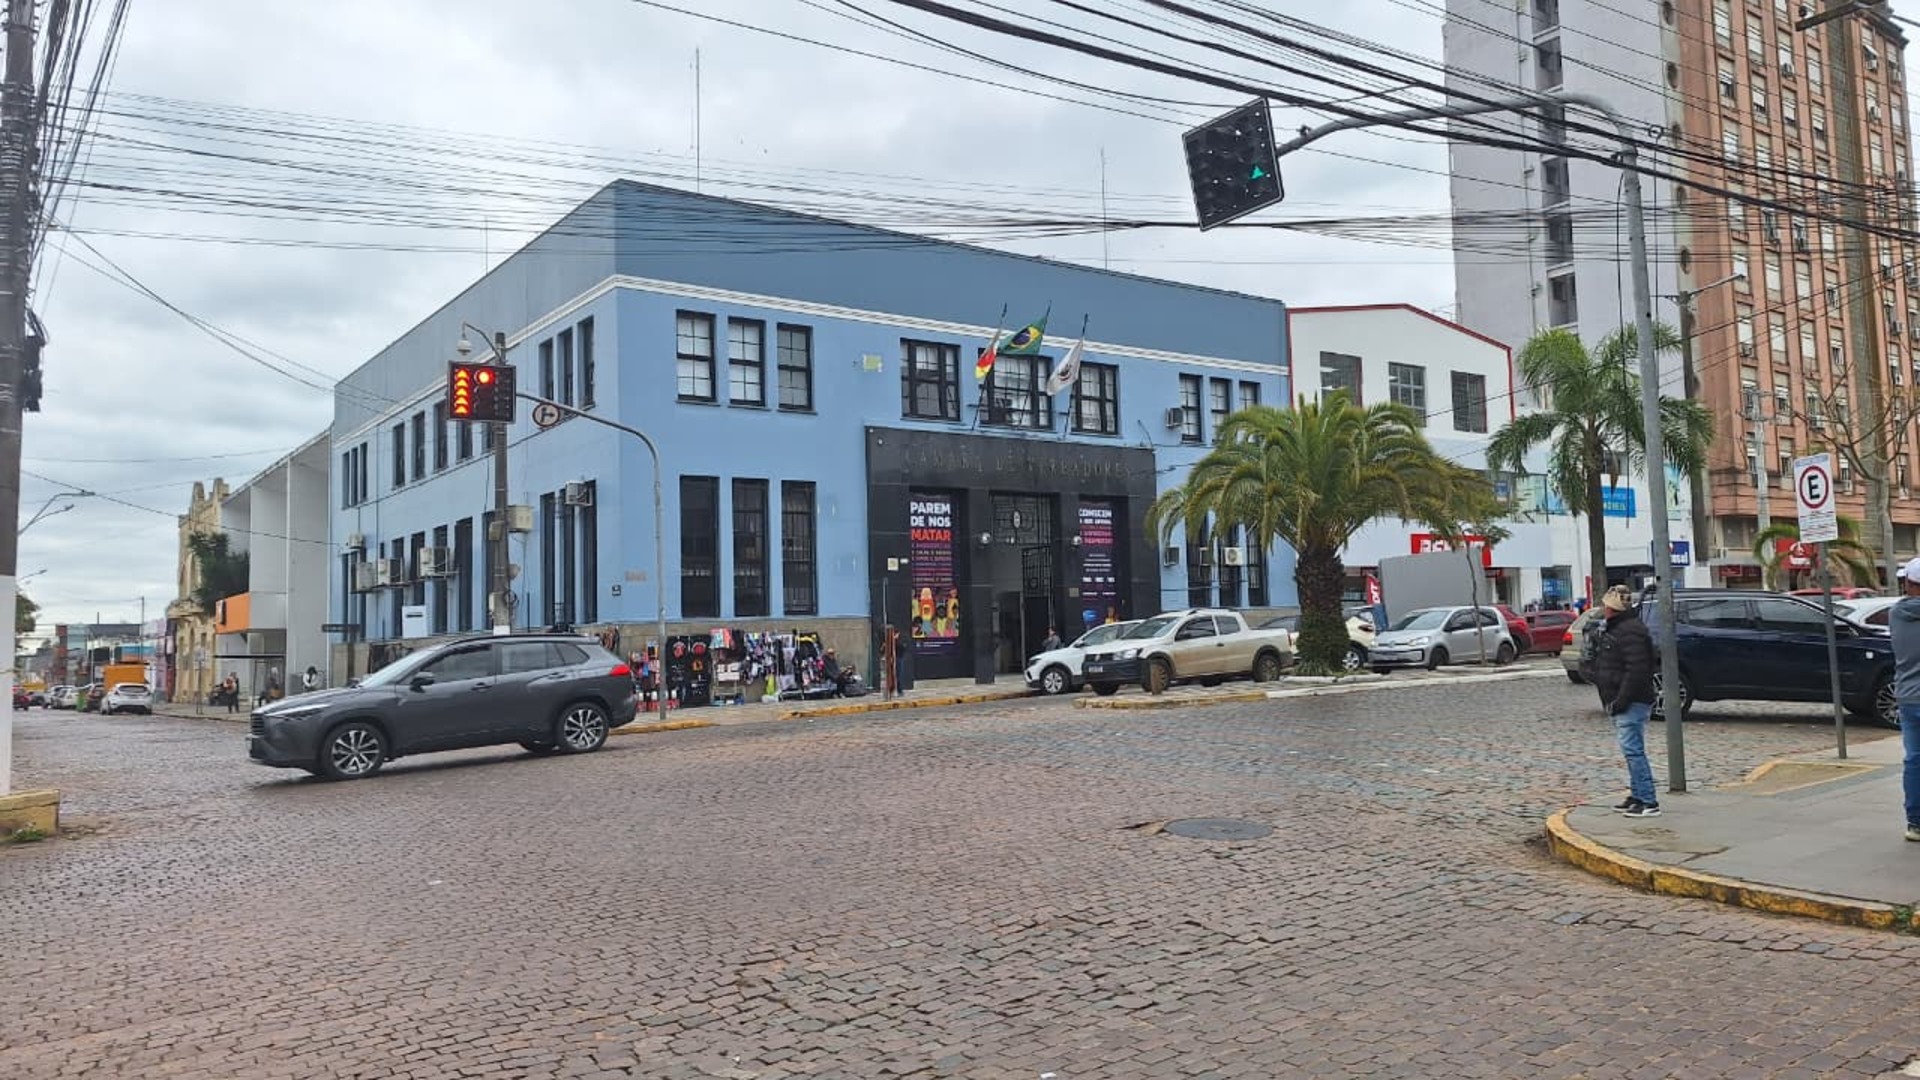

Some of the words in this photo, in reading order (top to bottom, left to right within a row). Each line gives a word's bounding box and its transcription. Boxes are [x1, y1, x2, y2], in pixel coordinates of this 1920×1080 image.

[1807, 474, 1821, 500] E
[910, 501, 951, 515] PAREM
[910, 516, 925, 528] DE
[928, 516, 951, 528] NOS
[911, 528, 952, 541] MATAR
